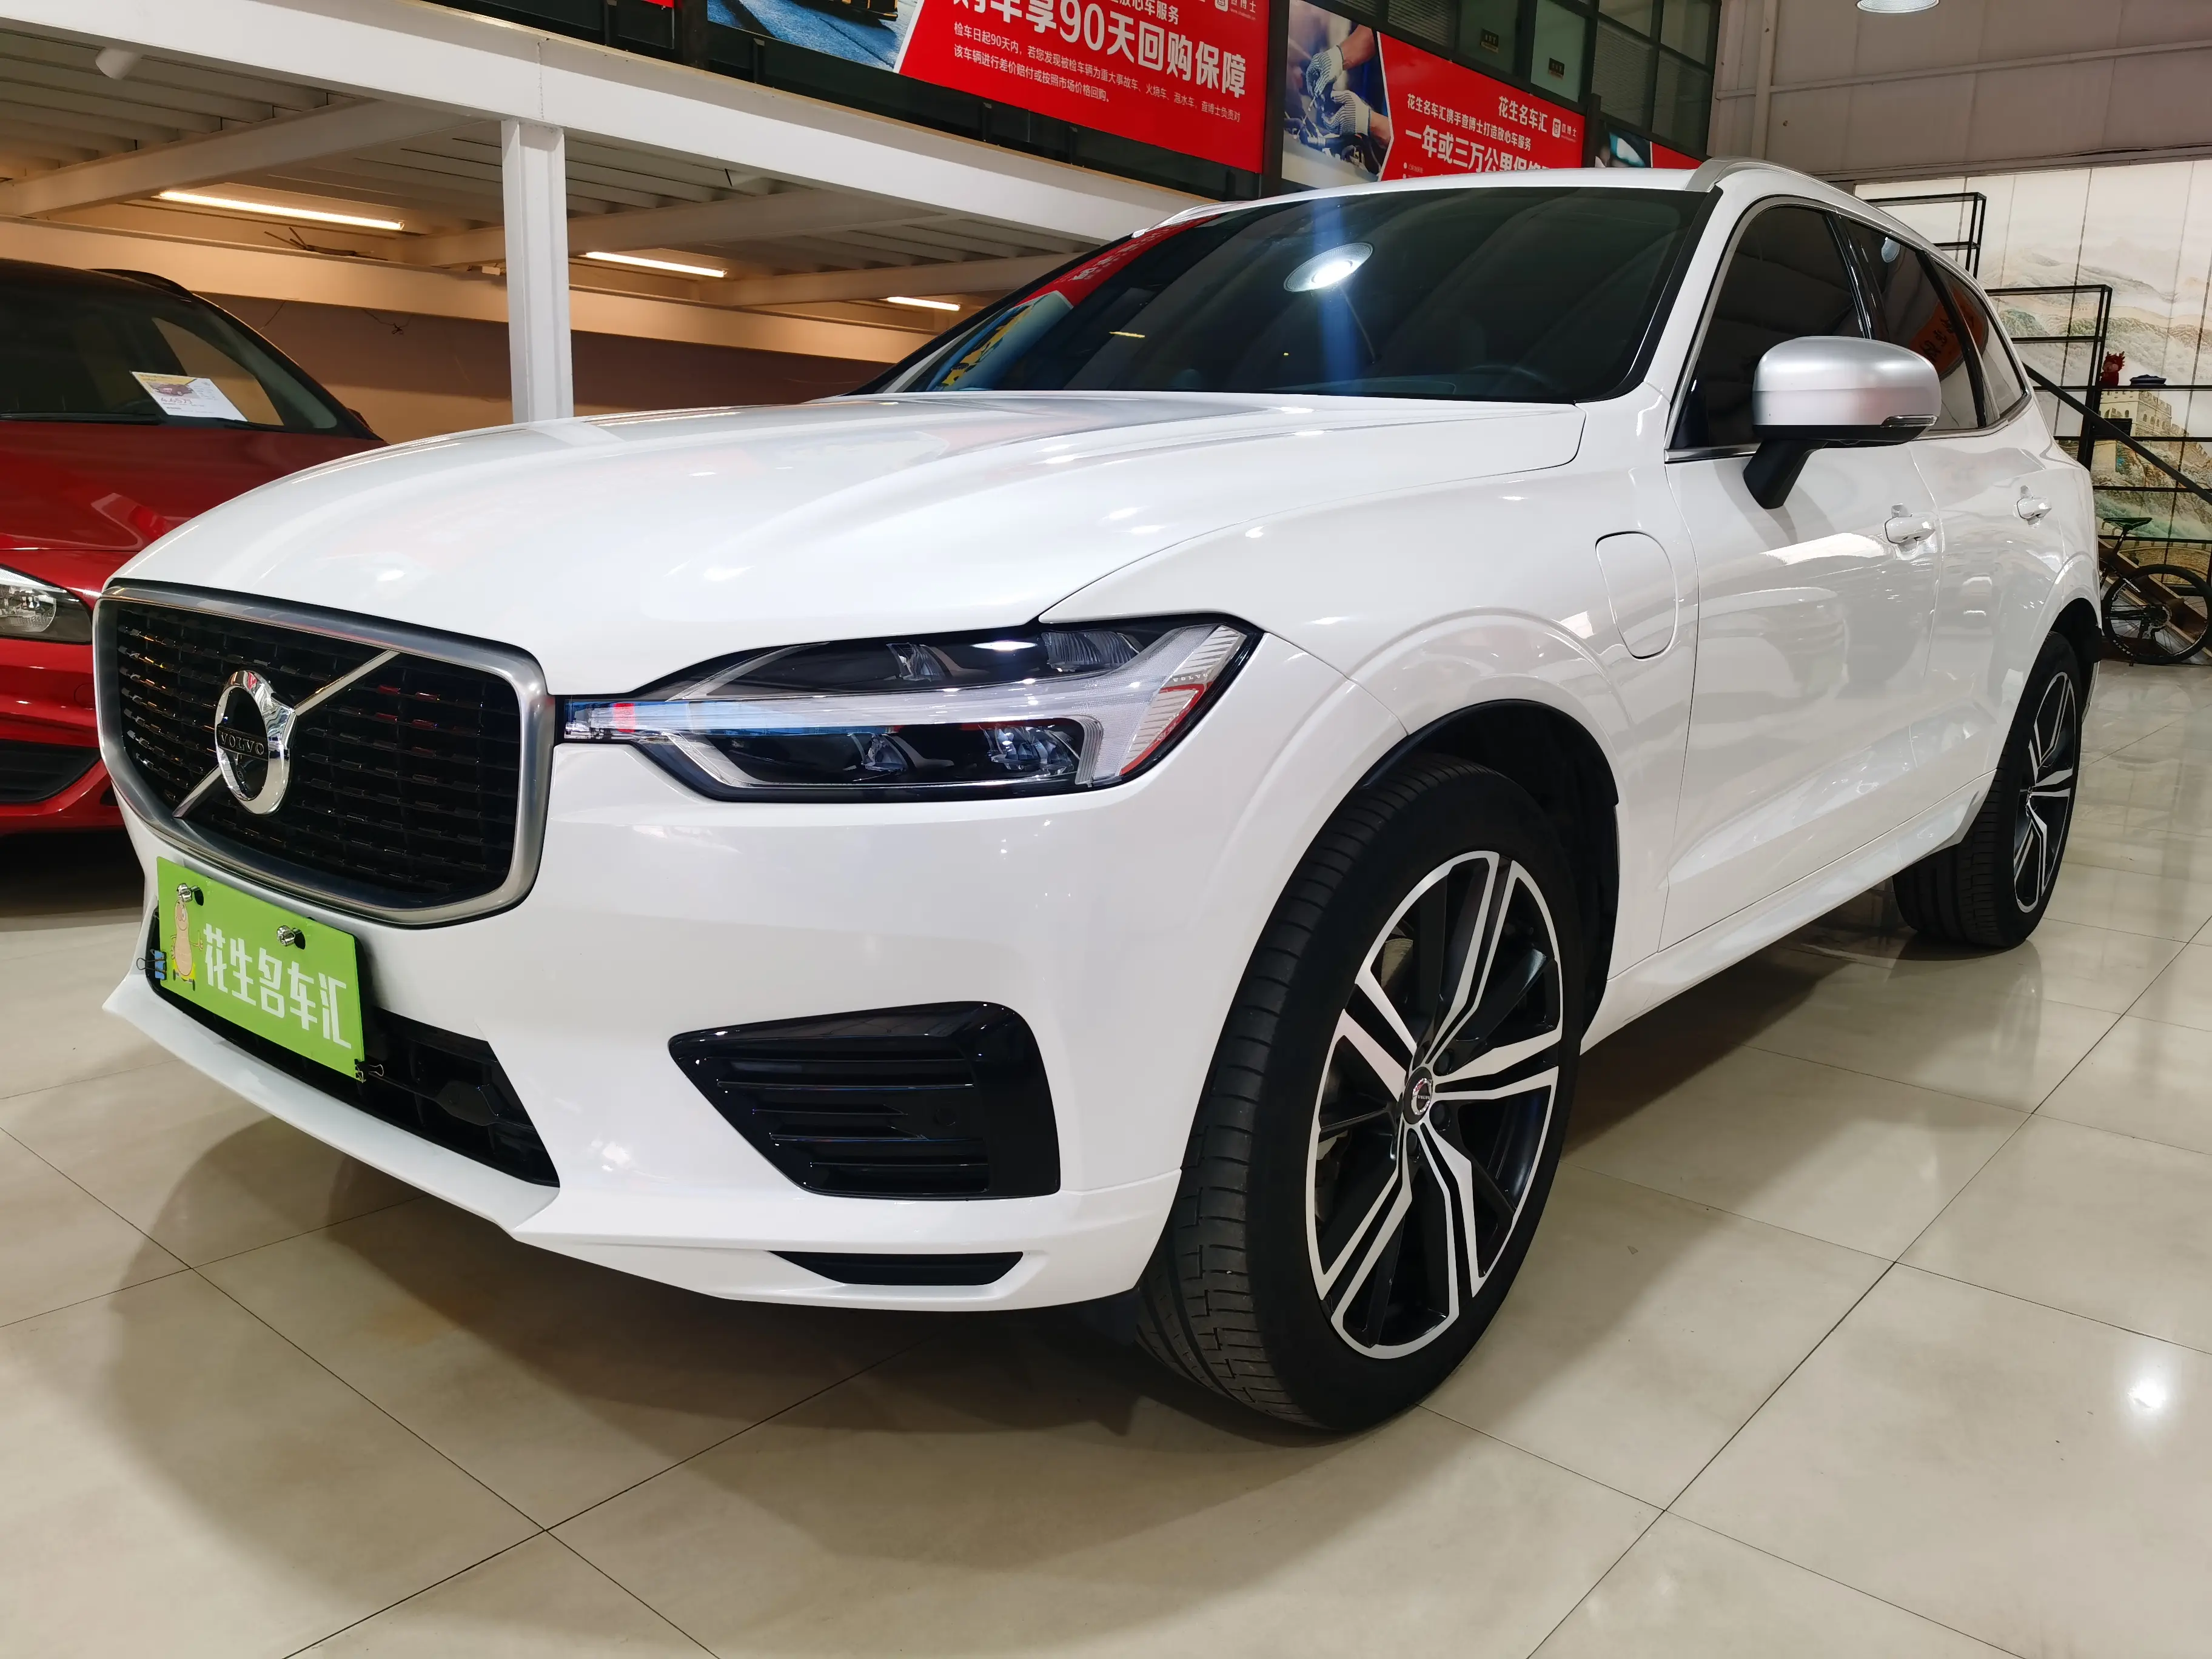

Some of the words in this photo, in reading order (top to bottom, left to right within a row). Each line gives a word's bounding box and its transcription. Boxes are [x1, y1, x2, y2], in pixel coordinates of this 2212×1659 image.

[1109, 0, 1179, 25] 心车服务
[953, 0, 1246, 98] 享90天回购保障
[1407, 93, 1532, 151] 花生名车汇携手查博士打造放心车服务
[1498, 96, 1548, 133] 花生名车汇
[1173, 673, 1208, 682] VOLVO
[220, 731, 264, 755] VOLVO
[204, 923, 352, 1049] 花生名车汇
